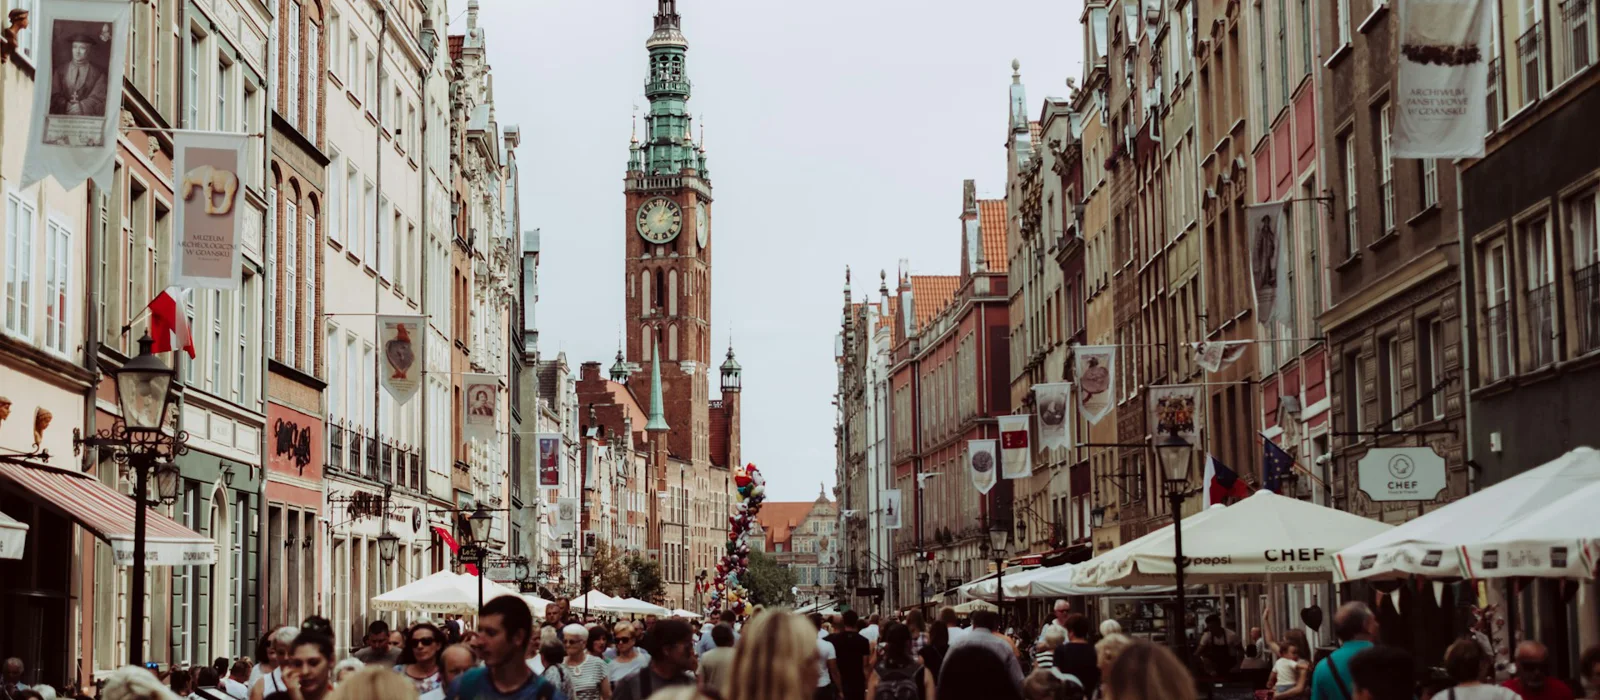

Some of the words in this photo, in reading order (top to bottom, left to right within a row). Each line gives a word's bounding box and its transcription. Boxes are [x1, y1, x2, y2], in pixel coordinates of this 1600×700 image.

[1411, 88, 1465, 96] ARCHIWUM
[1387, 481, 1418, 489] CHEF
[1264, 548, 1325, 562] CHEF
[1193, 555, 1232, 566] pepsi
